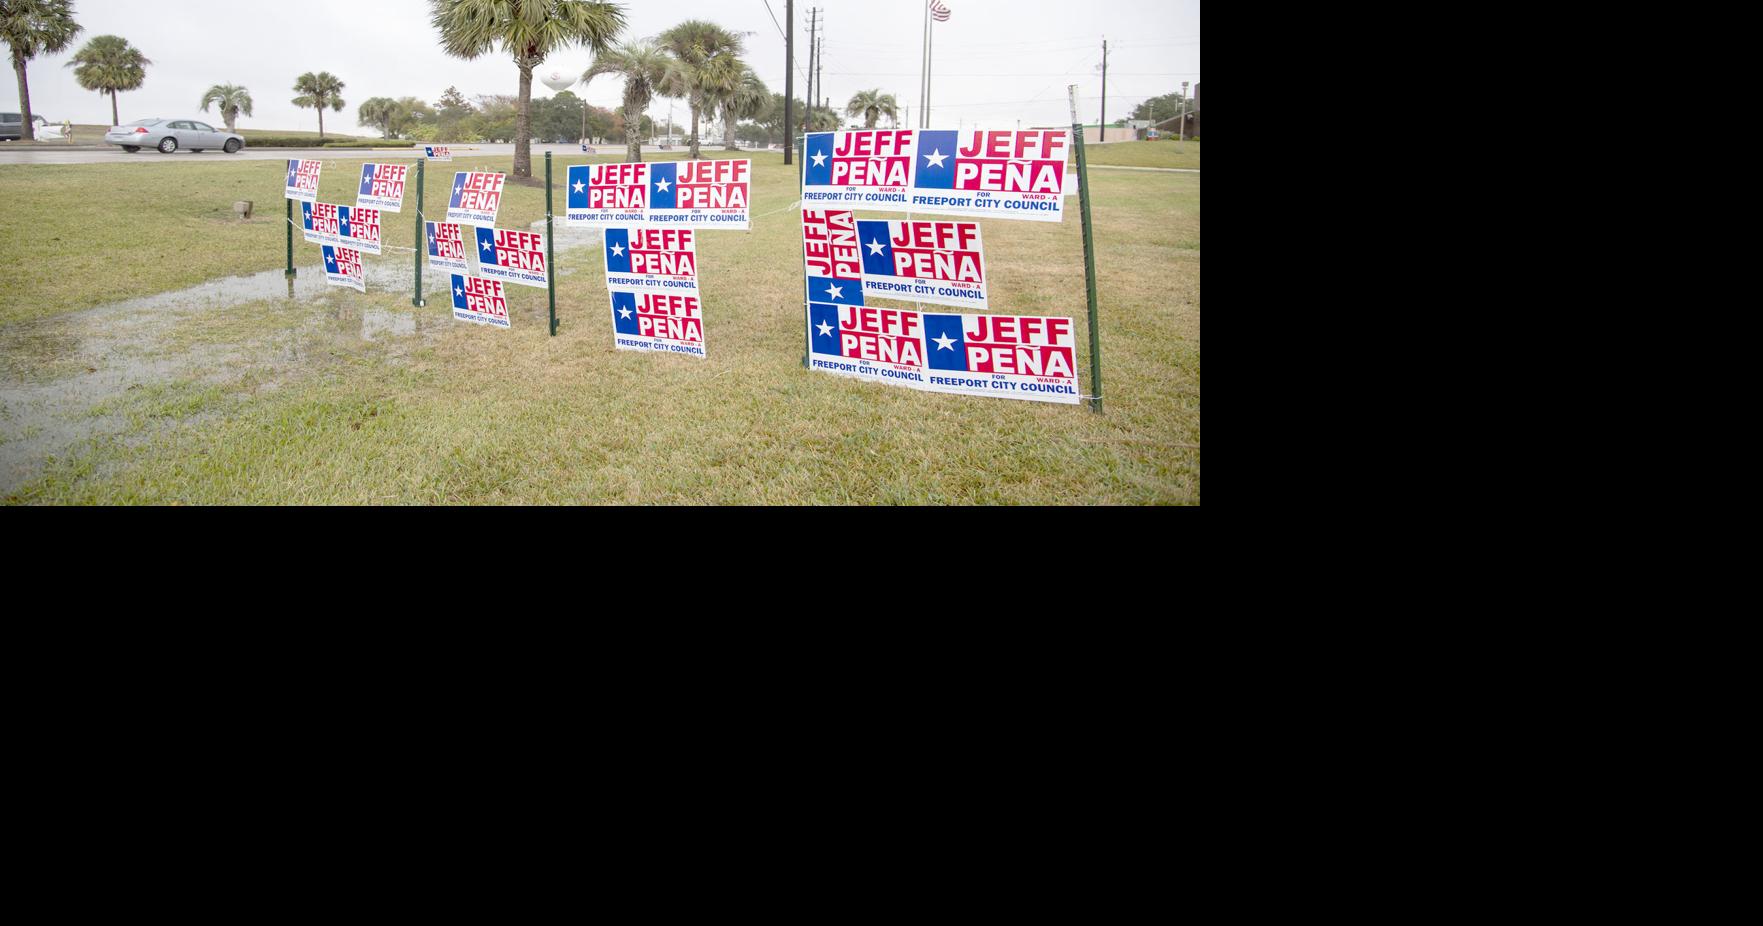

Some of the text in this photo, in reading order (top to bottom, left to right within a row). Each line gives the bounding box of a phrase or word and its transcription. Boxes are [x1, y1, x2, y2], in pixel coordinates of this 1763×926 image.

[836, 130, 912, 156] JEFF
[960, 130, 1066, 158] JEFF
[298, 160, 320, 174] JEFF
[375, 165, 406, 180] JEFF
[591, 164, 646, 185] JEFF
[678, 160, 748, 184] JEFF
[832, 157, 908, 186] PEÑA
[956, 160, 1060, 193] PEÑA
[465, 173, 503, 190] JEFF
[460, 190, 496, 211] PEÑA
[590, 185, 645, 208] PEÑA
[677, 183, 746, 208] PEÑA
[804, 192, 842, 200] FREEPORT
[866, 194, 907, 202] COUNCIL
[912, 196, 972, 206] FREEPORT
[975, 199, 1001, 208] CITY
[1004, 200, 1060, 211] COUNCIL
[313, 202, 336, 217] JEFF
[350, 208, 378, 223] JEFF
[436, 223, 459, 239] JEFF
[495, 230, 541, 250] JEFF
[631, 229, 692, 250] JEFF
[892, 222, 976, 250] JEFF
[803, 209, 830, 275] JEFF
[828, 210, 860, 279] PEÑA
[336, 247, 359, 262] JEFF
[496, 250, 545, 272] PEÑA
[631, 250, 695, 276] PEÑA
[894, 250, 982, 283] PEÑA
[466, 277, 501, 296] JEFF
[522, 274, 546, 282] COUNCIL
[866, 281, 984, 299] FREEPORT CITY COUNCIL
[467, 295, 507, 316] PEÑA
[638, 294, 698, 316] JEFF
[638, 316, 702, 342] PEÑA
[841, 307, 918, 336] JEFF
[966, 316, 1069, 345] JEFF
[618, 338, 704, 354] FREEPORT CITY COUNCIL
[841, 334, 922, 367] PEÑA
[813, 360, 923, 381] FREEPORT CITY COUNCIL
[967, 345, 1073, 378] PEÑA
[930, 376, 1076, 394] FREEPORT CITY COUNCIL
